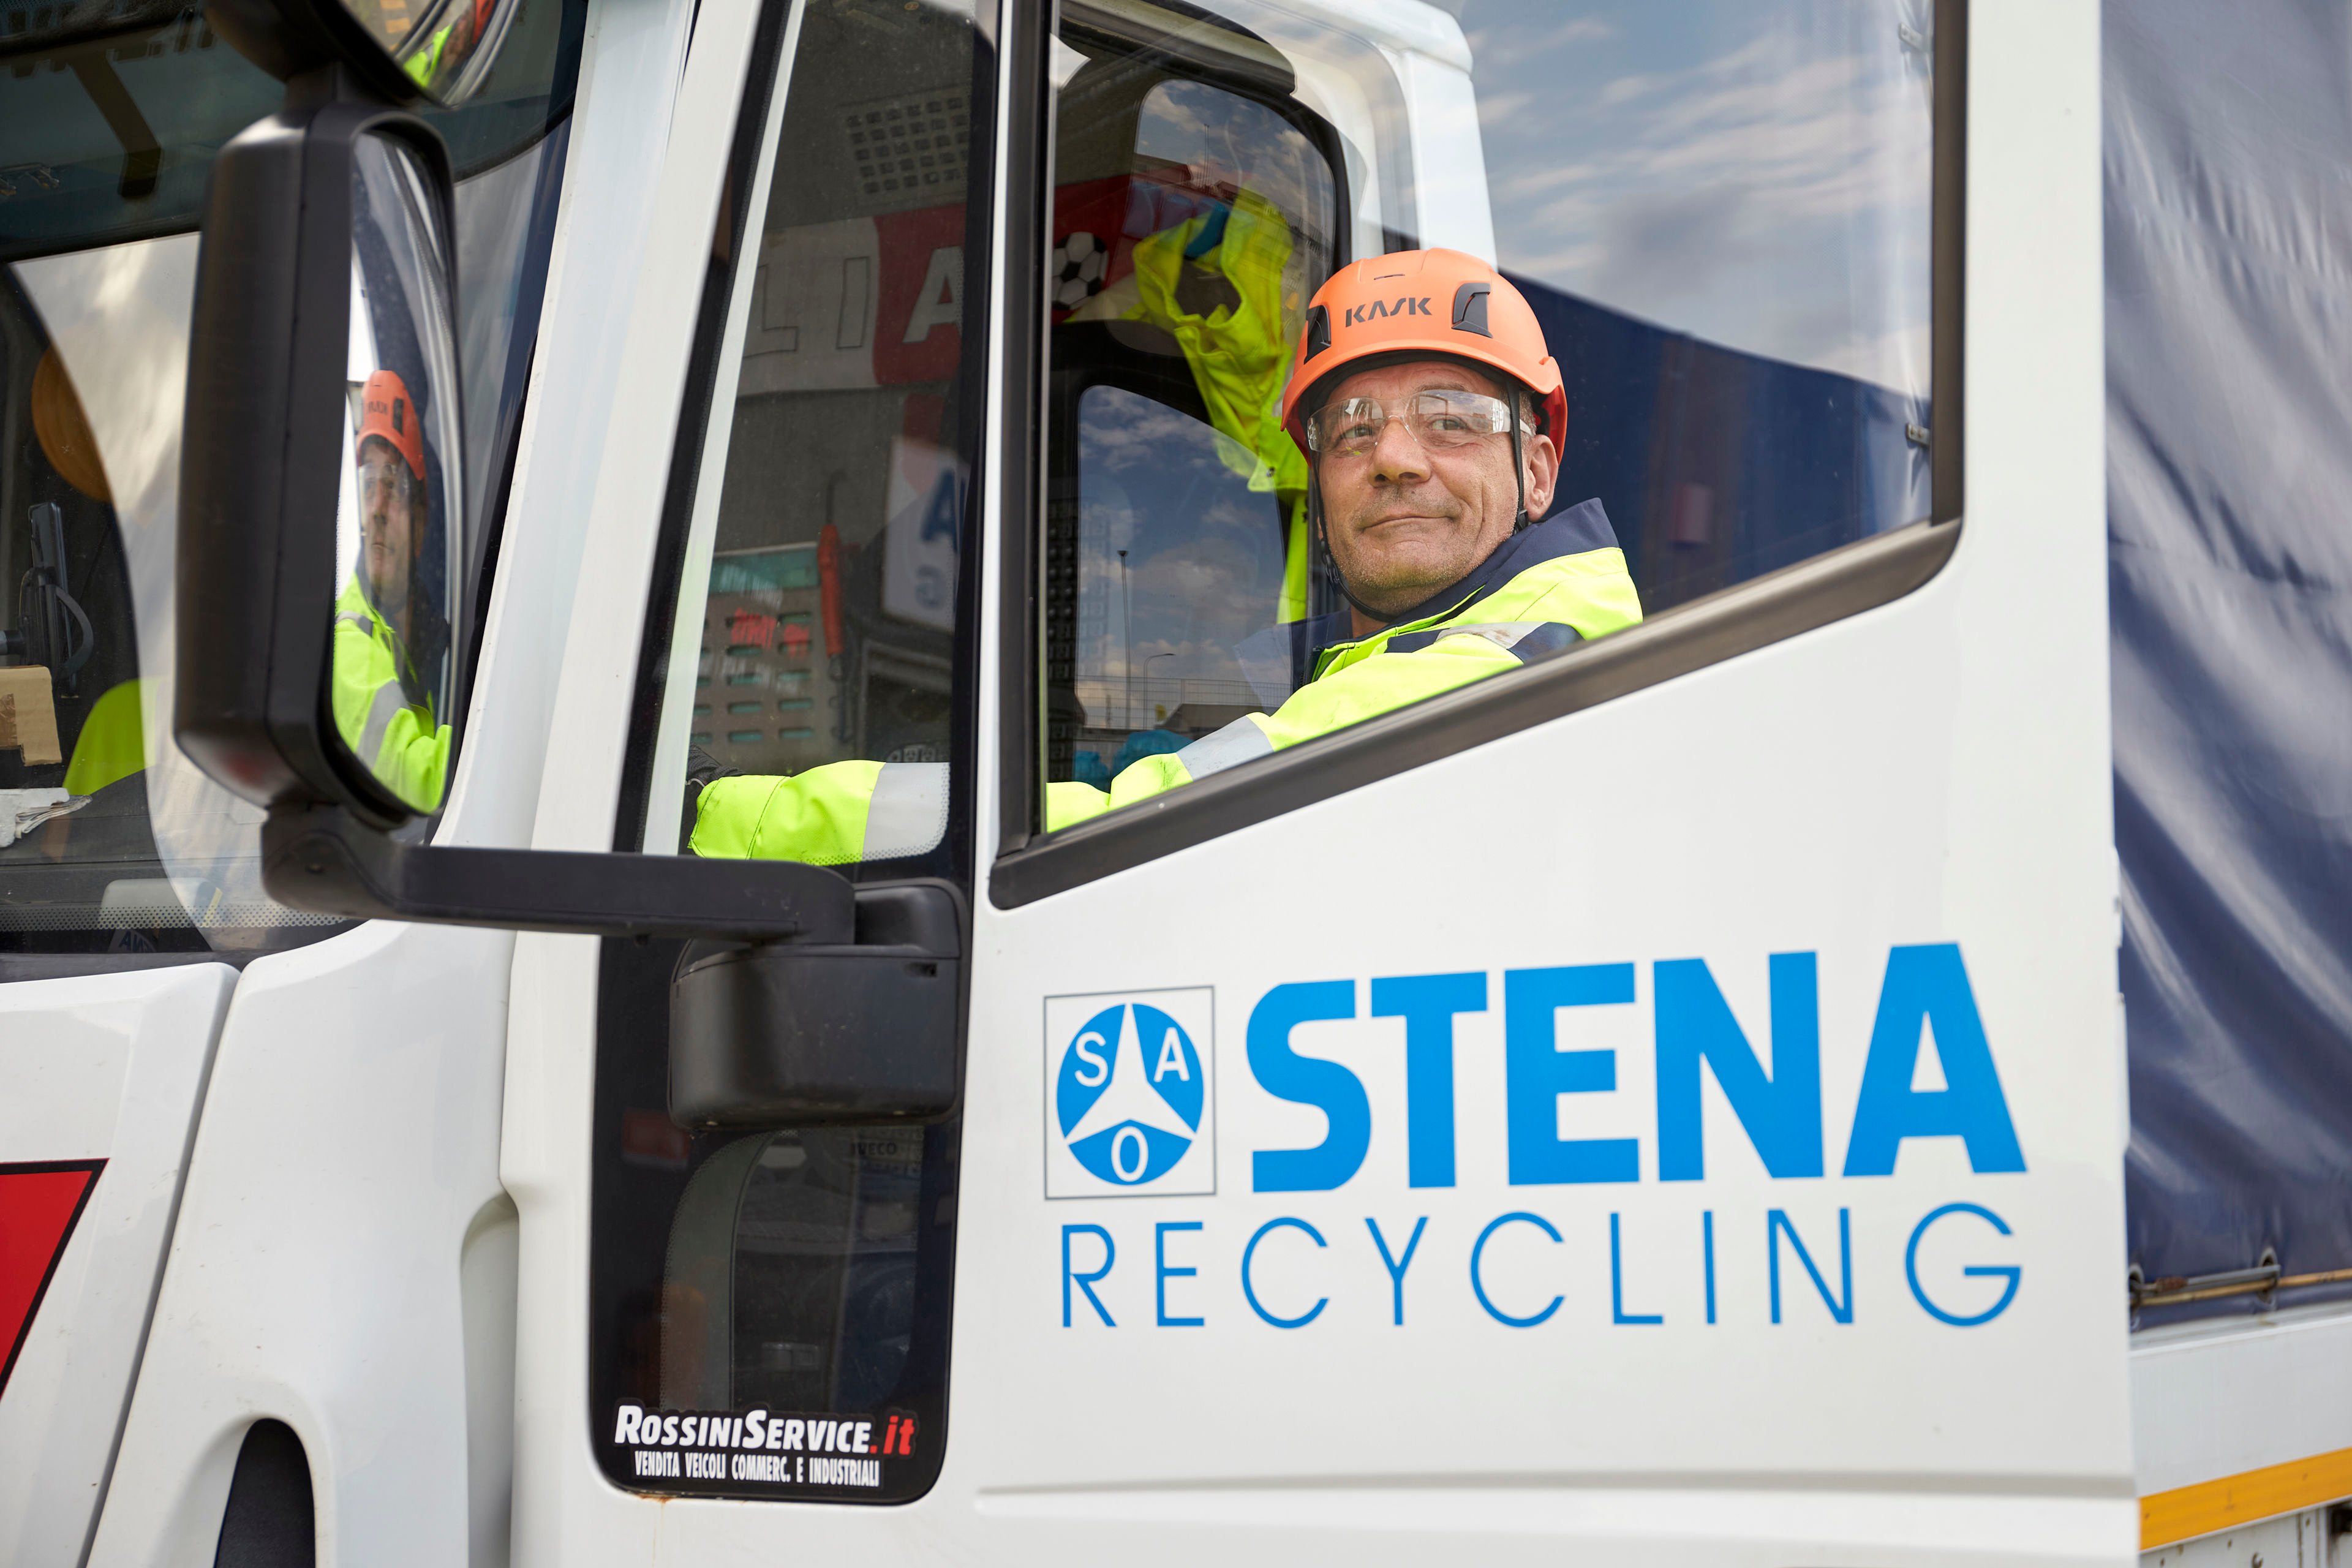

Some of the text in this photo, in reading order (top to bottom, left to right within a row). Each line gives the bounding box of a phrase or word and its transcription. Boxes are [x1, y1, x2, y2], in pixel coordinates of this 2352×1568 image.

[1345, 297, 1433, 328] KASK
[1246, 942, 2028, 1193] STENA
[850, 1142, 897, 1156] IVECO
[1061, 1202, 2022, 1330] RECYCLING
[635, 1450, 880, 1487] VENDITA VEICOLI COMMERC. E INDUSTRIALI
